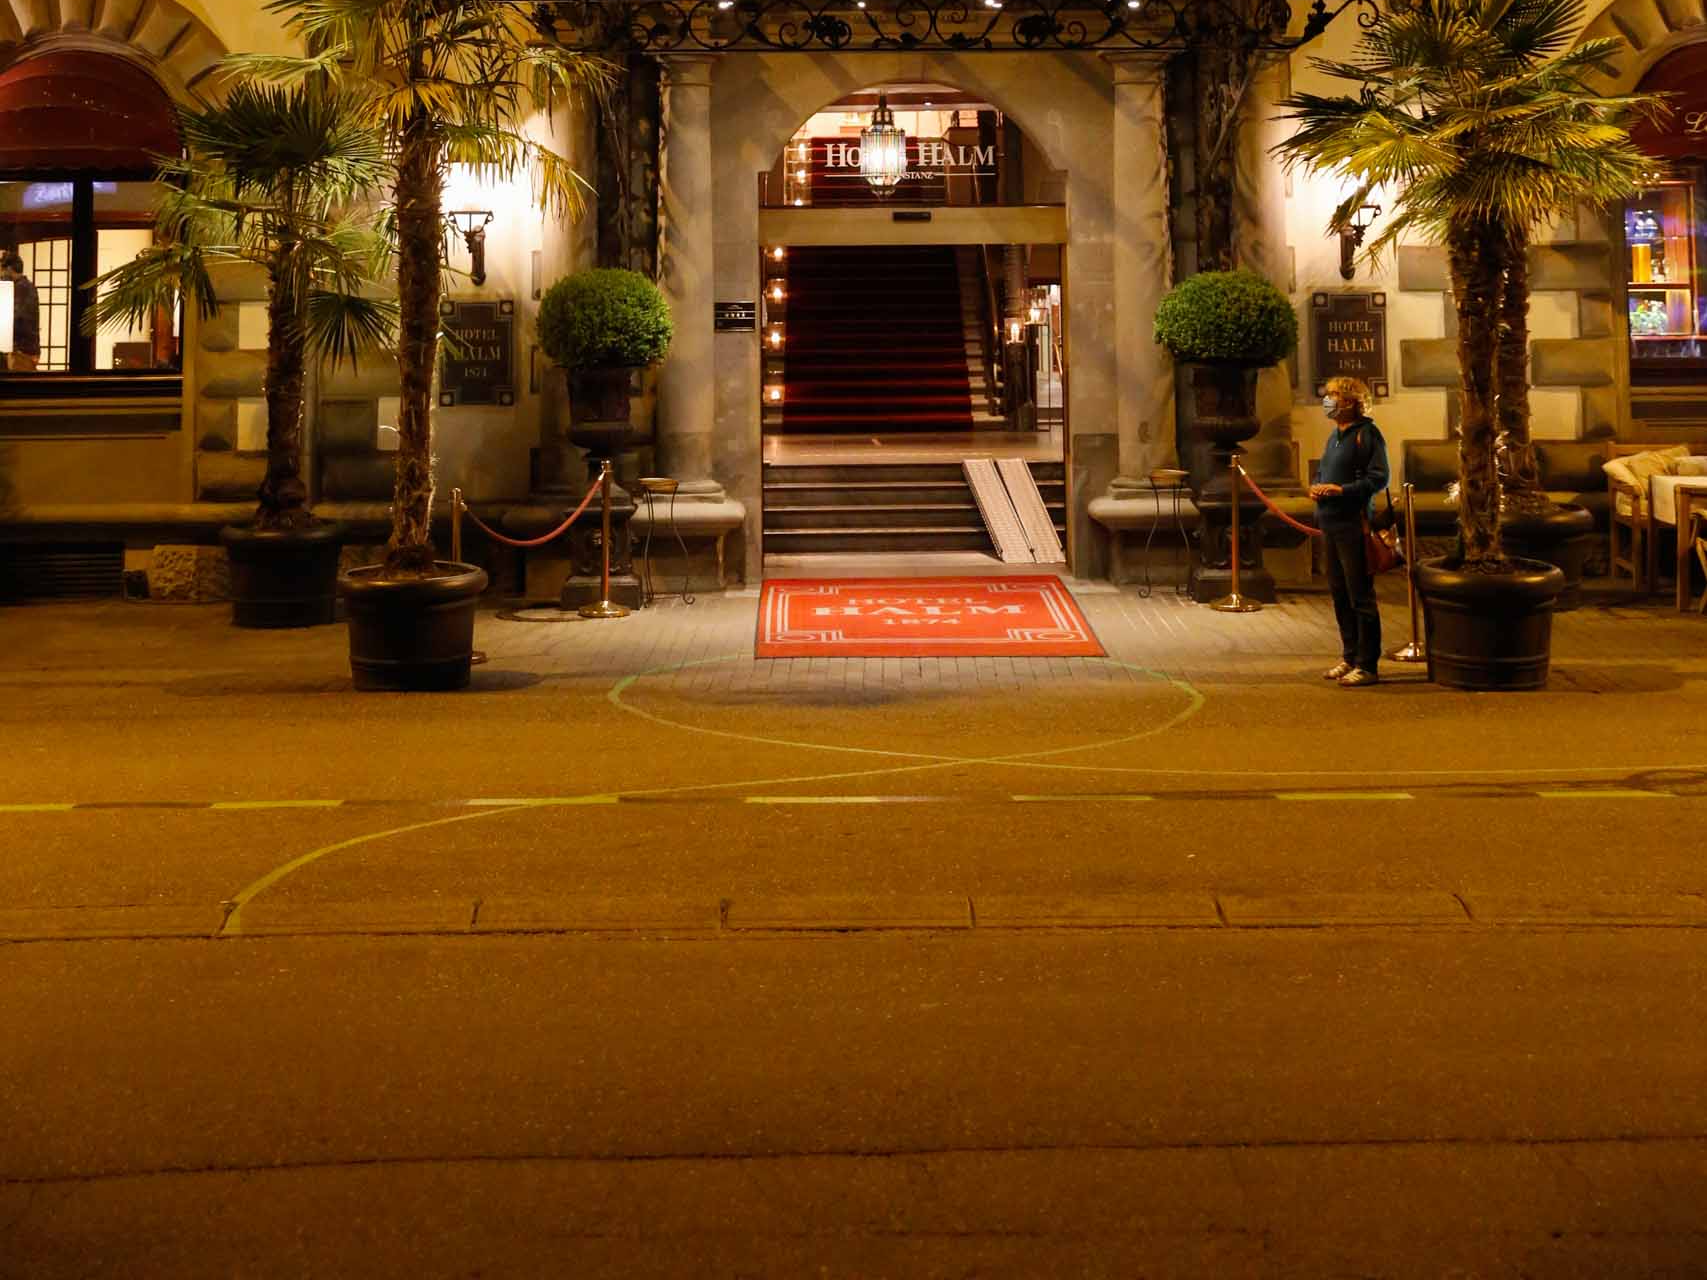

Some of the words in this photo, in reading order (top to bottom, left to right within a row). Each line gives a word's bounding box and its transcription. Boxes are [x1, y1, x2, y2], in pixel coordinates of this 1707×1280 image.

[917, 142, 996, 167] HALM
[1328, 320, 1373, 332] HOTEL
[1328, 338, 1375, 353] HALM
[848, 597, 988, 606] HOTEL
[811, 605, 1026, 616] HALM
